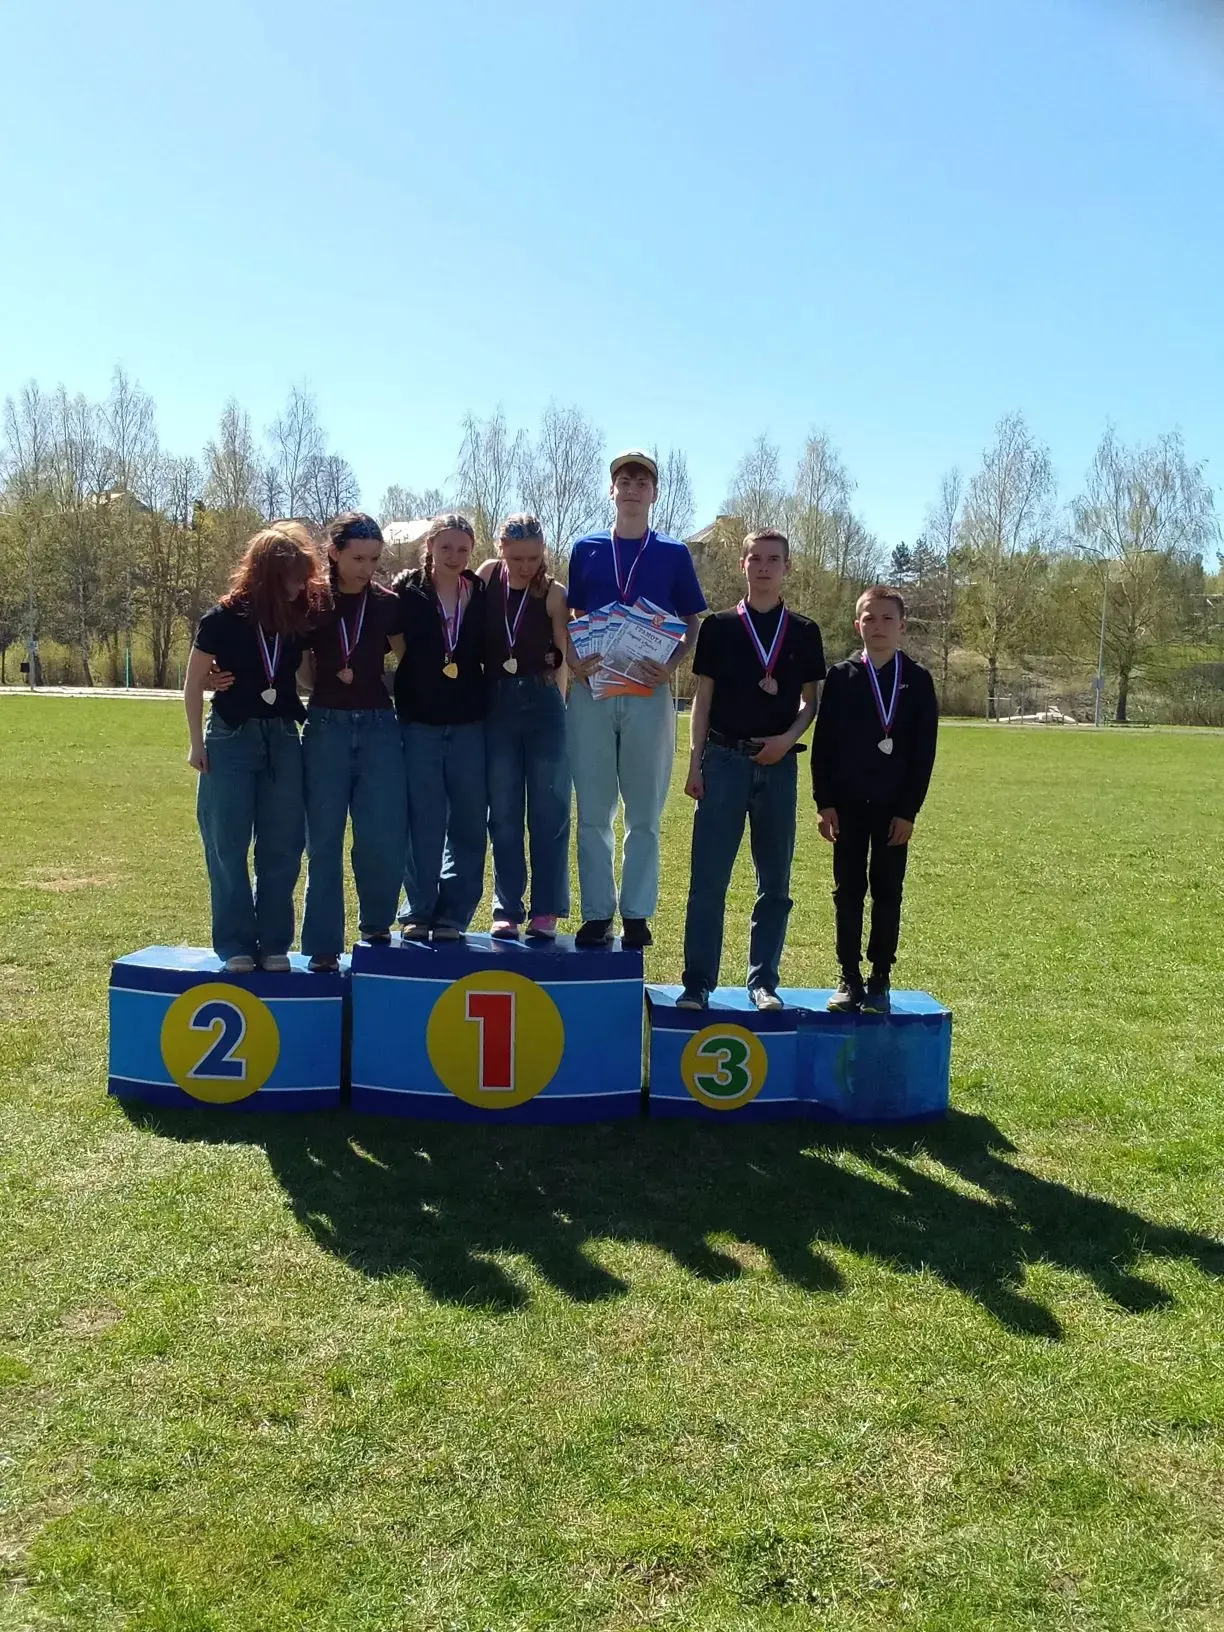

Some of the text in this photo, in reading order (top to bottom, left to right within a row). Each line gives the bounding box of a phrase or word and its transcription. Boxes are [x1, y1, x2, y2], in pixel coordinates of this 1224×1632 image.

[635, 625, 663, 645] ГРАМОТА
[187, 999, 247, 1081] 2
[465, 990, 516, 1092] 1
[693, 1035, 752, 1099] 3
